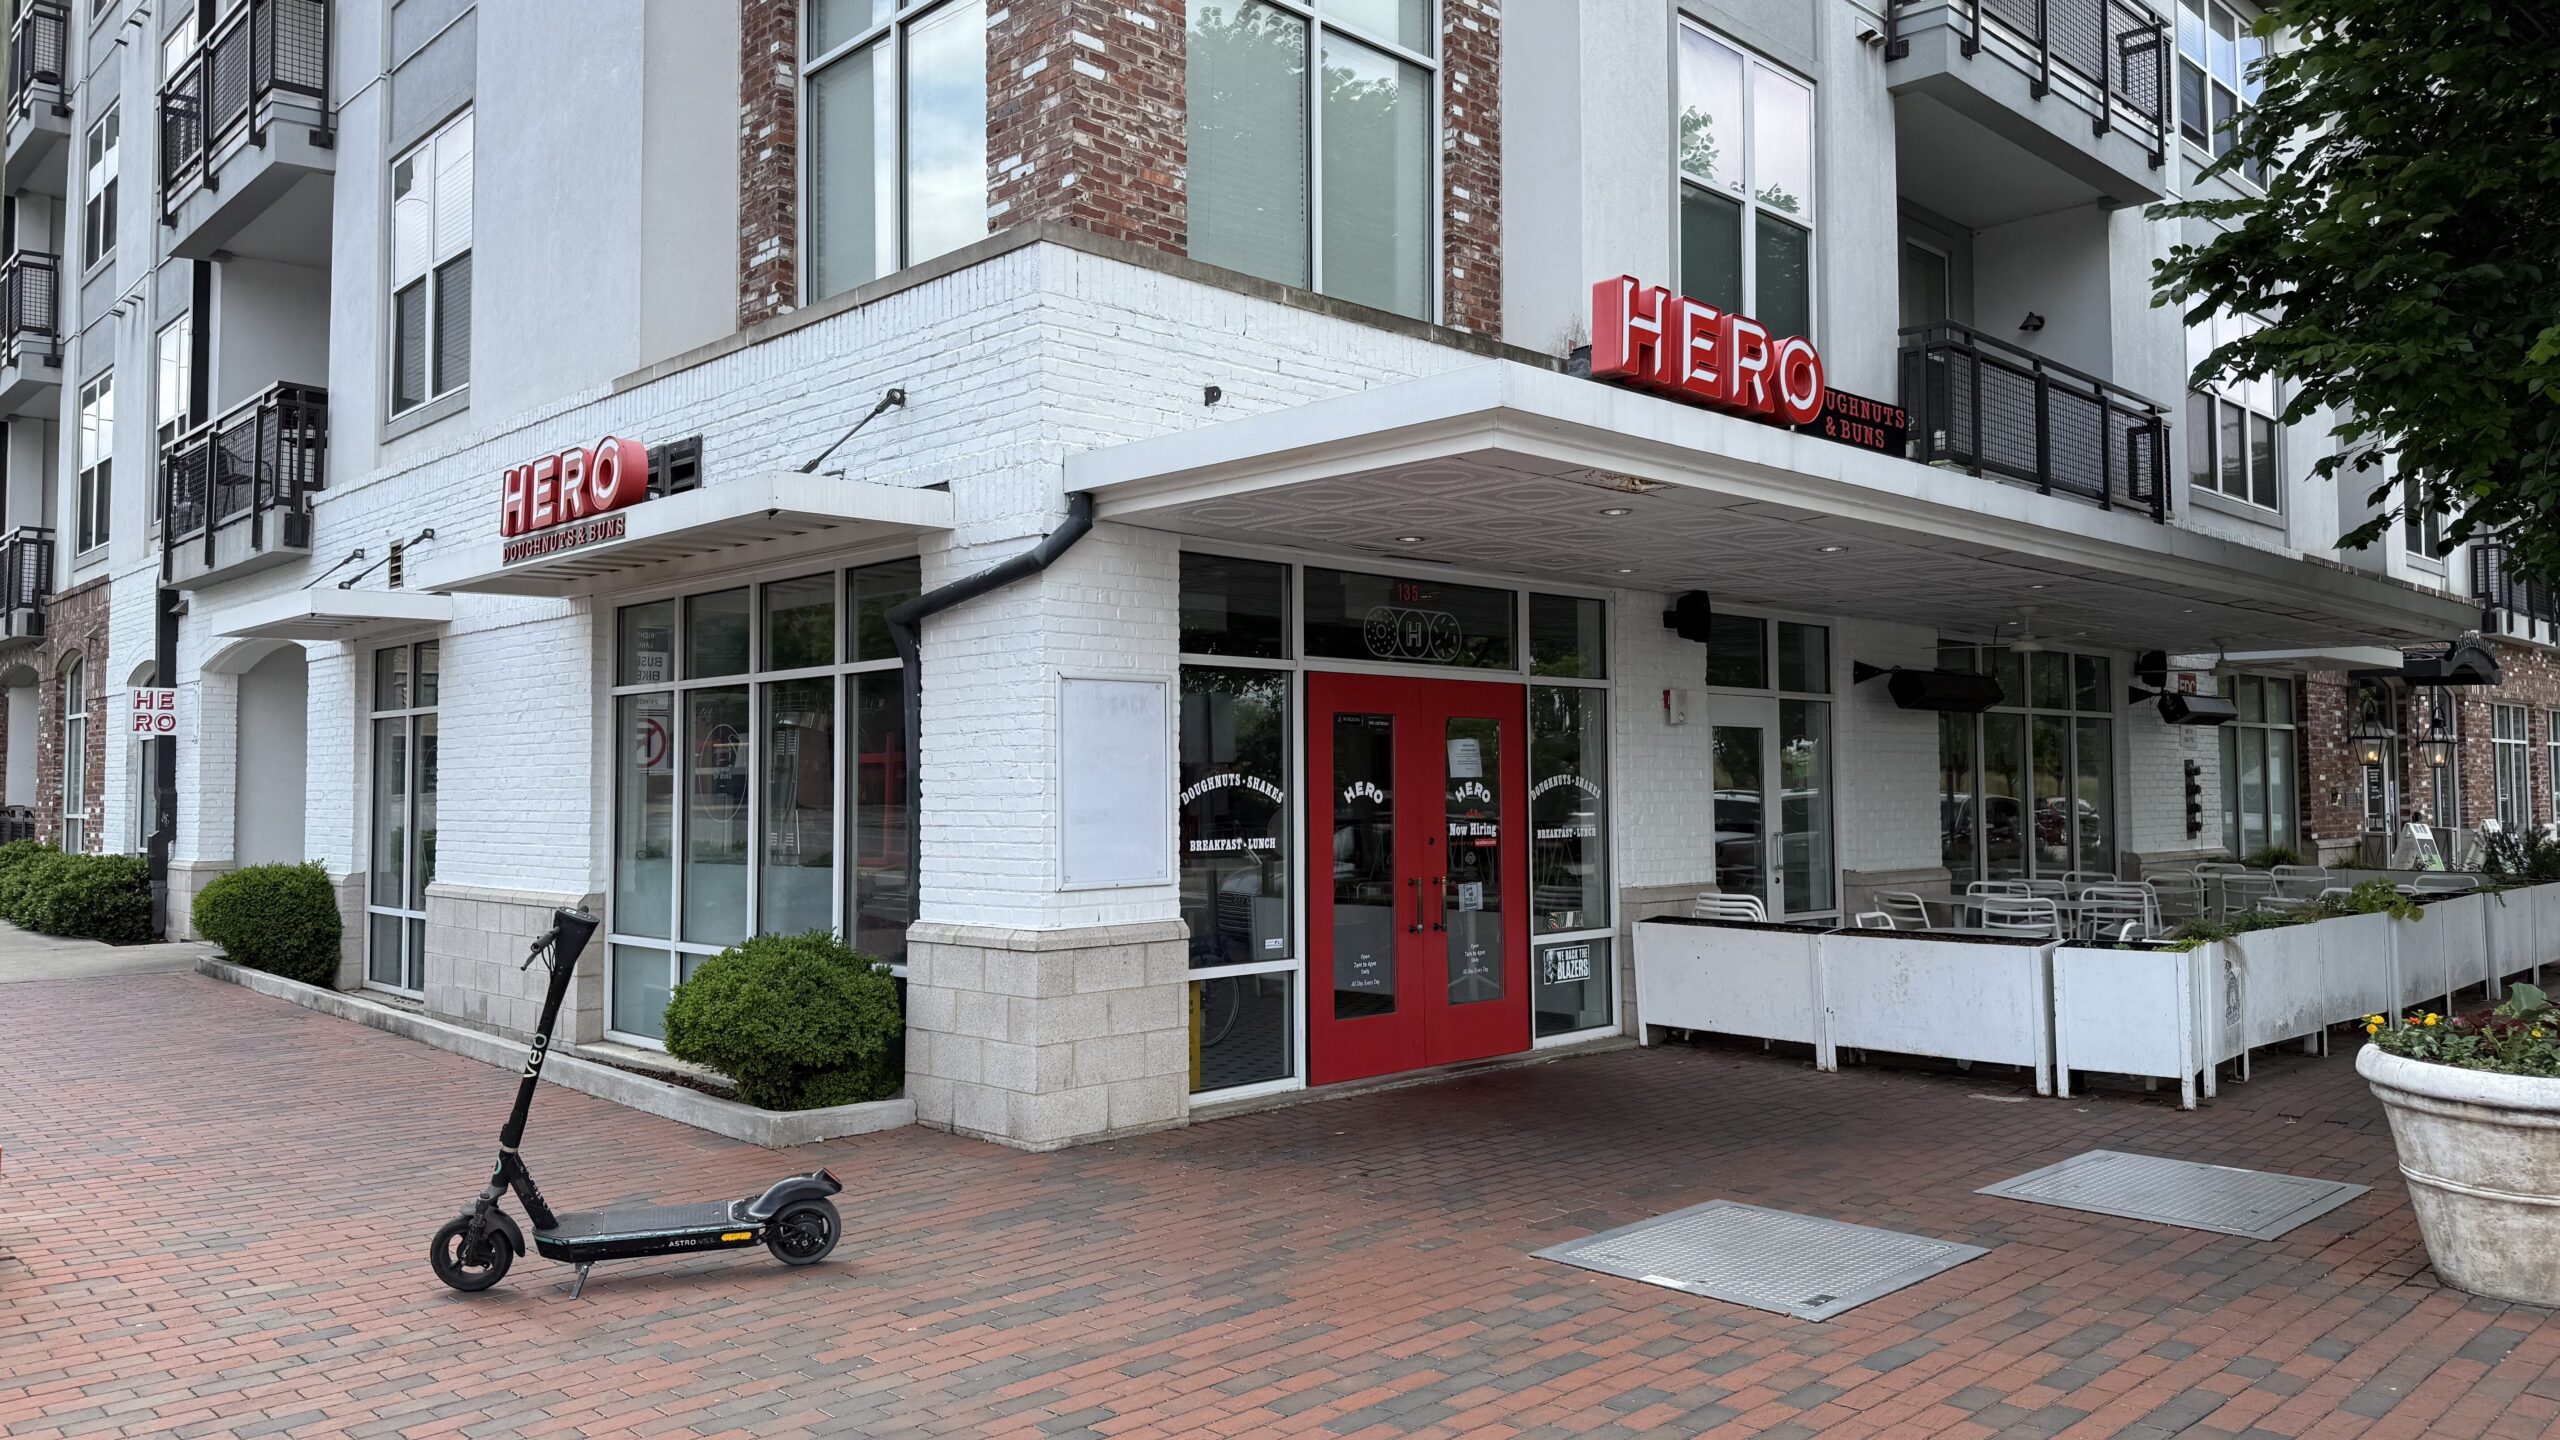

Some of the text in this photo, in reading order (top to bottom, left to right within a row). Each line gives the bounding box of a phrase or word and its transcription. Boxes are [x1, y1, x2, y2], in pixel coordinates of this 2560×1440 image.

[1597, 275, 1825, 425] HERO
[1825, 390, 1905, 429] UGHNUTS
[1825, 416, 1885, 449] & BUNS
[501, 436, 640, 537] HERO
[503, 517, 625, 563] DOUGHNUTS & BUNS
[1397, 583, 1419, 601] 135
[1406, 621, 1422, 647] H
[1181, 774, 1284, 805] DOUGHNUTS SHAKES
[1343, 781, 1383, 804] HERO
[1455, 782, 1491, 803] HERO
[1531, 774, 1601, 801] DOUGHNUTS SHAKES
[1449, 822, 1497, 837] Now Hiring
[1537, 827, 1596, 839] BREAKFAST LUNCH
[1190, 838, 1276, 852] BREAKFAST LUNCH
[1557, 948, 1588, 961] WE BACK THE
[1557, 959, 1588, 980] BLAZERS
[523, 1033, 547, 1078] veo
[669, 1239, 697, 1247] ASTRO
